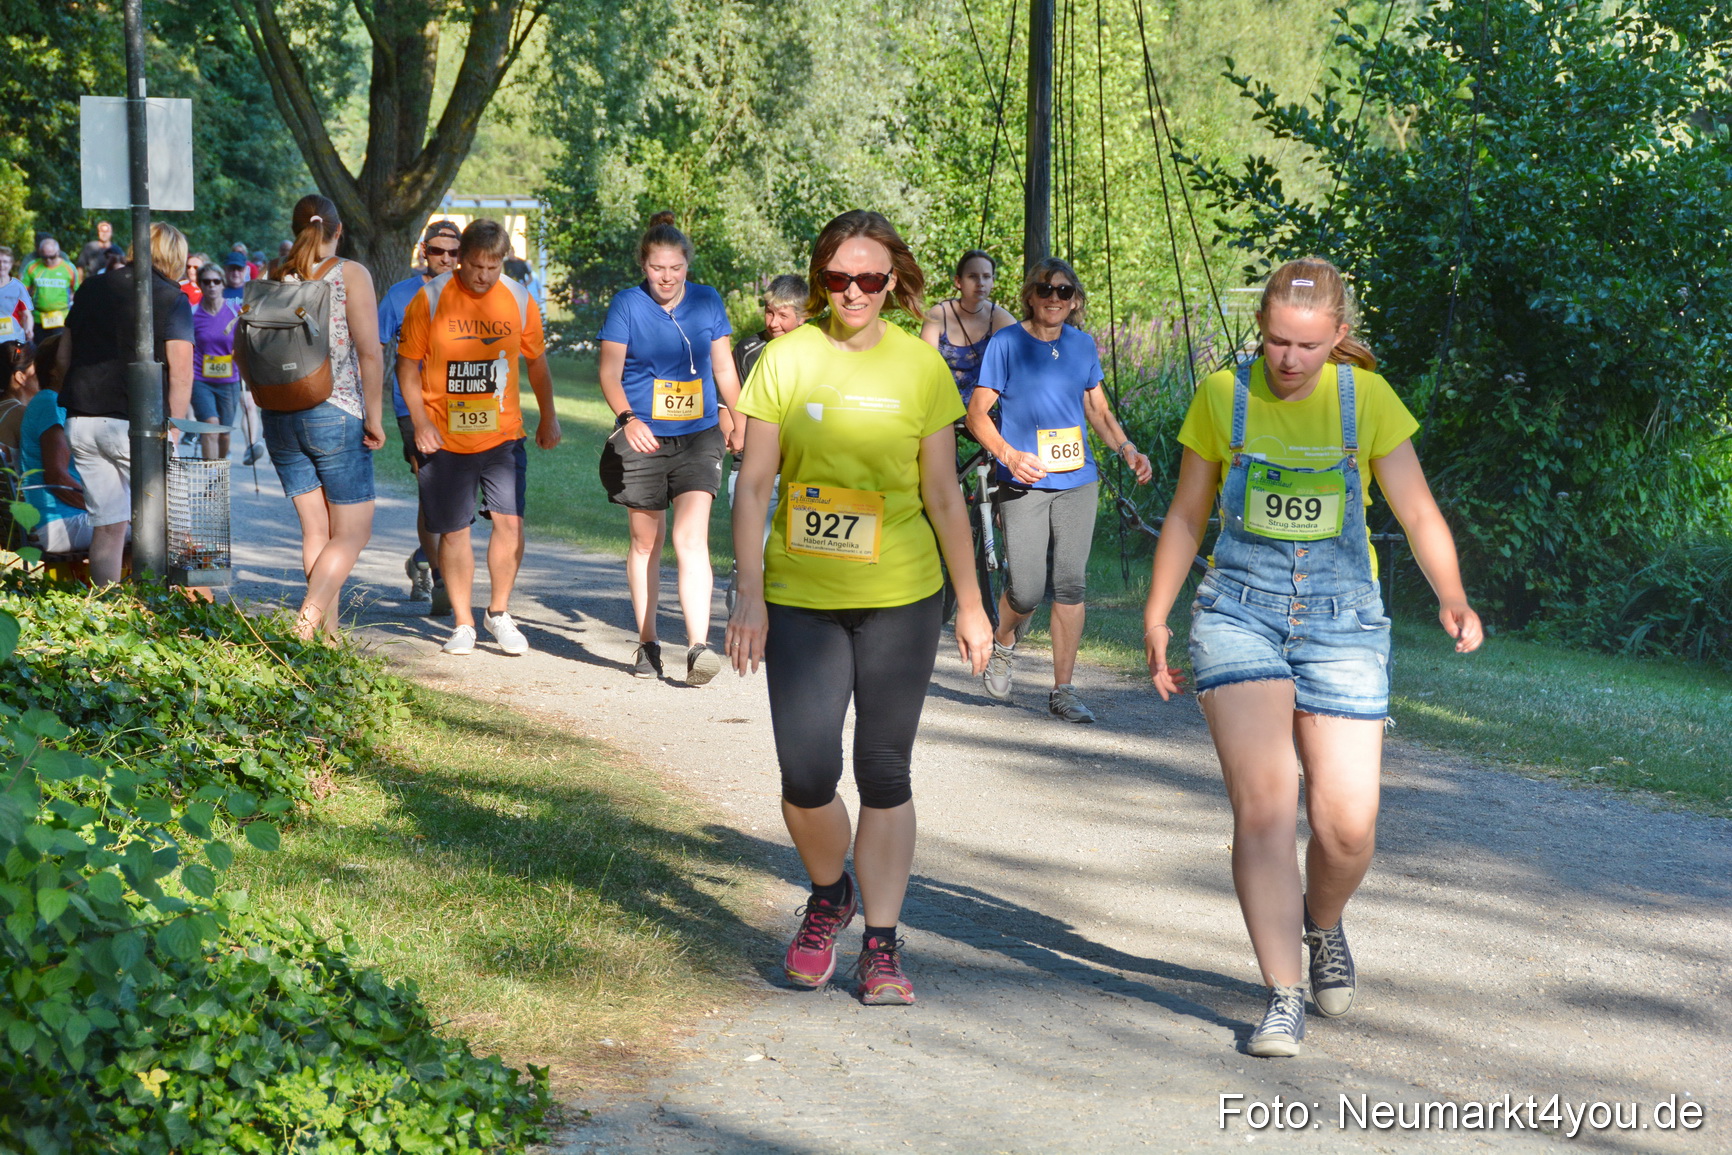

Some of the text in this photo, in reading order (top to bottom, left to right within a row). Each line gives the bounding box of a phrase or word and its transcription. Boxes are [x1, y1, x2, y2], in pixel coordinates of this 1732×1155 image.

[457, 320, 512, 336] WINGS
[209, 363, 227, 372] 460
[448, 378, 487, 393] BEI UNS
[665, 394, 694, 410] 674
[459, 411, 488, 425] 193
[1051, 441, 1080, 460] 668
[1265, 493, 1322, 521] 969
[805, 511, 860, 540] 927
[1268, 519, 1318, 529] Strug Sandra
[827, 539, 860, 549] Angelika
